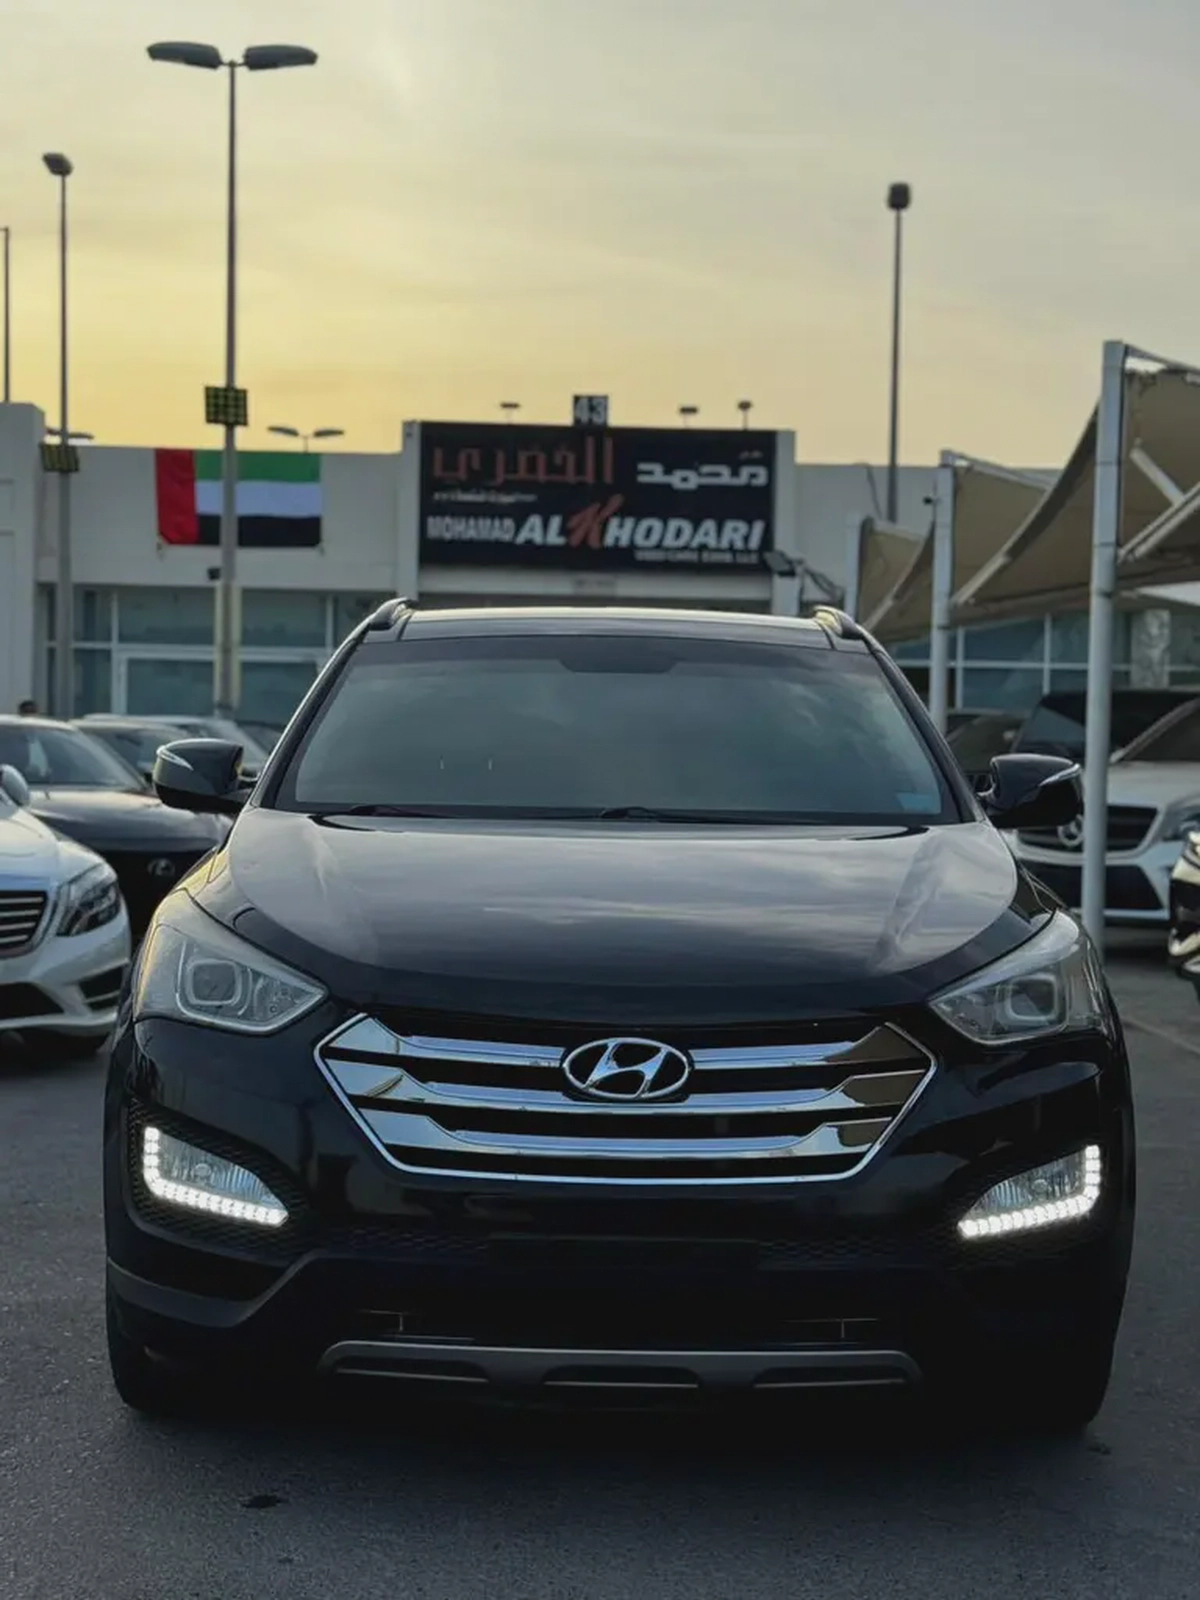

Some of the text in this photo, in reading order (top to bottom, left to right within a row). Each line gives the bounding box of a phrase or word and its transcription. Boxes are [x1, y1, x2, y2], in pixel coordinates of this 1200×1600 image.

[575, 396, 607, 425] 43
[636, 461, 769, 490] محمد
[427, 515, 515, 541] MOHAMAD
